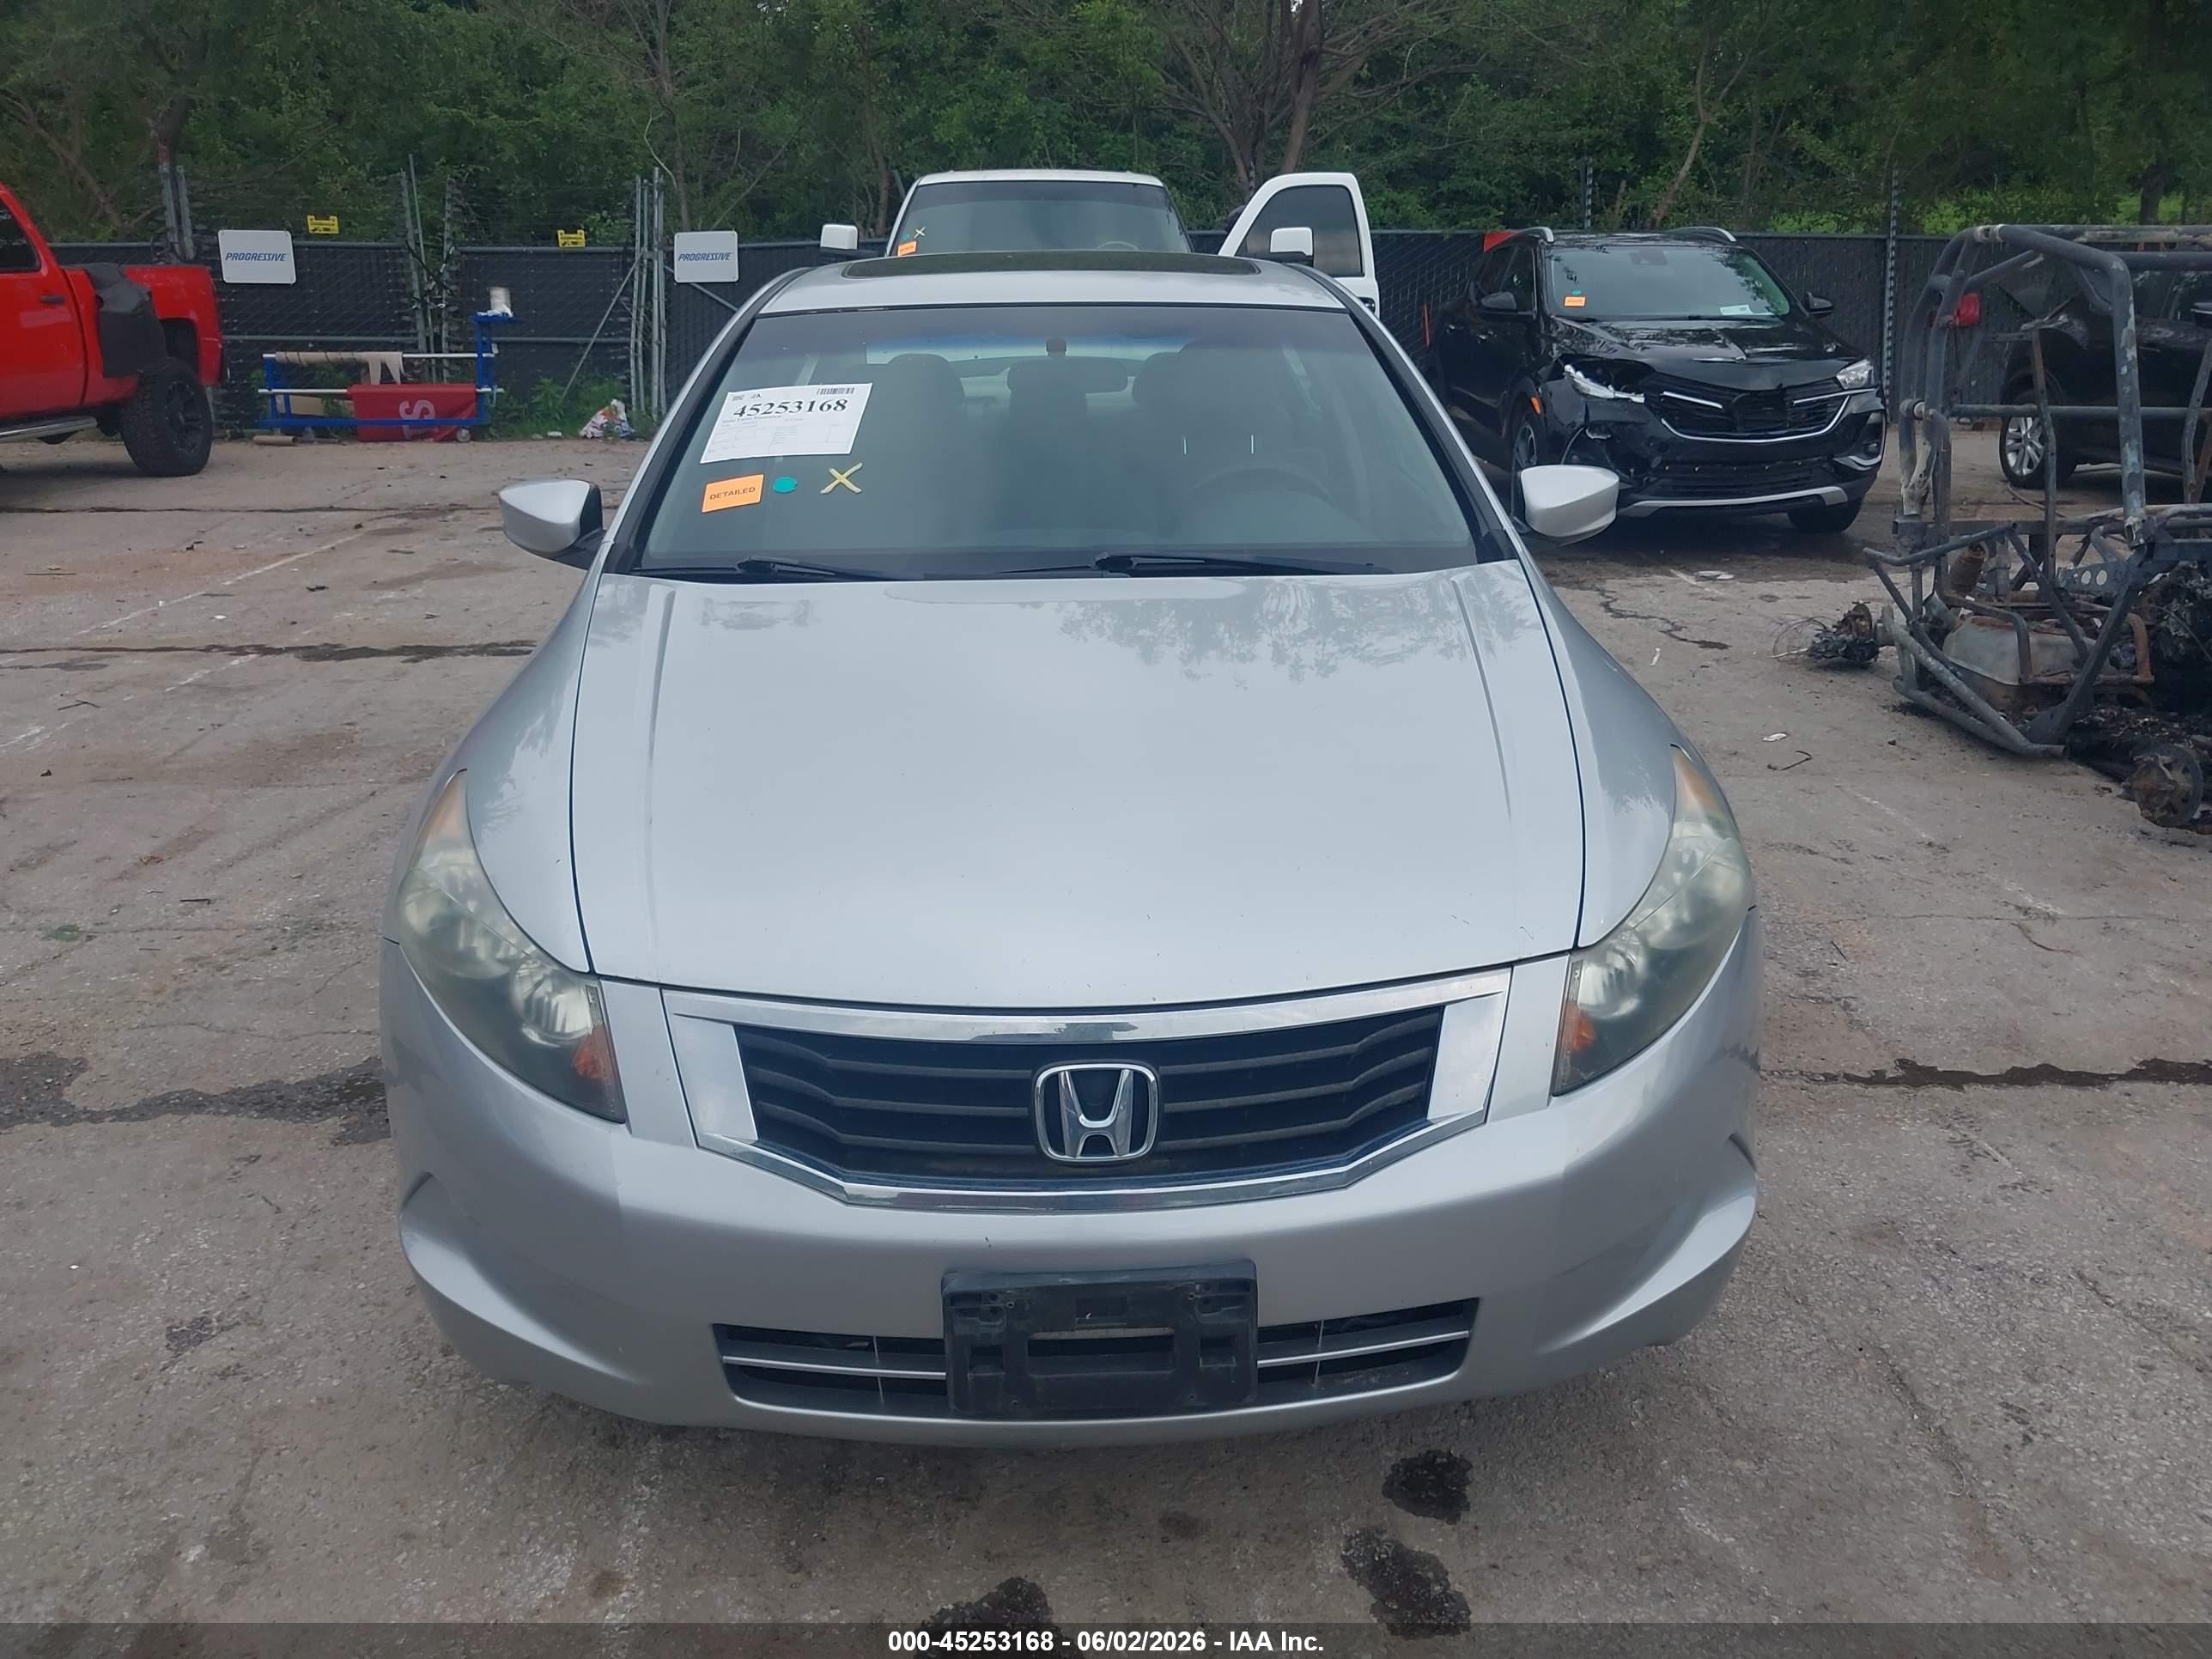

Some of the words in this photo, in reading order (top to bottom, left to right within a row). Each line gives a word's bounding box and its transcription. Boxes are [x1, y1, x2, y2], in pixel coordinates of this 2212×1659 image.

[225, 252, 287, 262] PROGRESSIVE
[678, 252, 732, 262] PROGRESSIVE
[733, 398, 848, 417] 45253168
[709, 486, 756, 501] DETAILED
